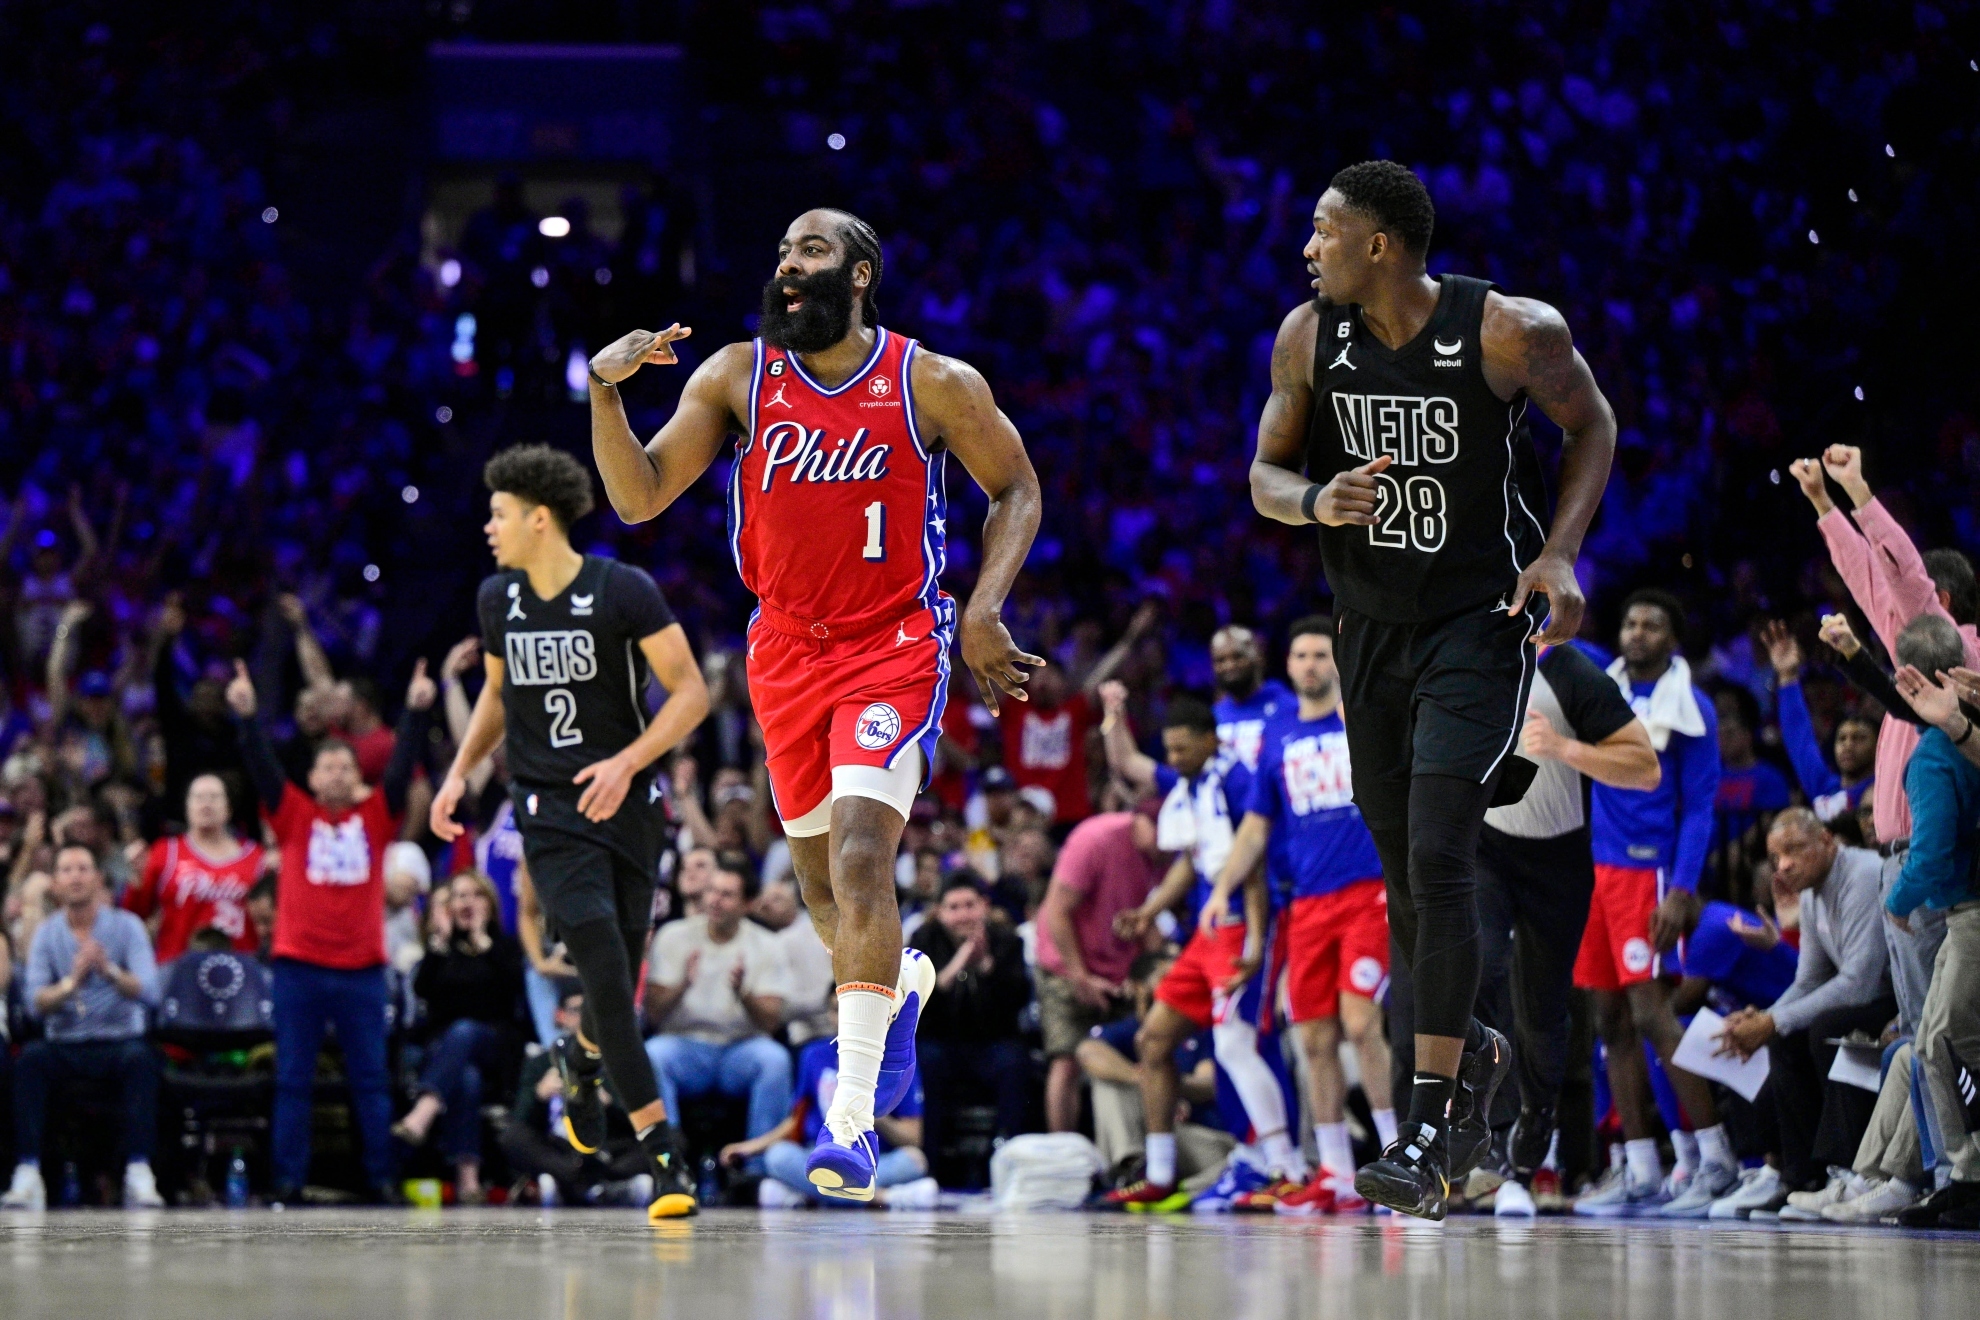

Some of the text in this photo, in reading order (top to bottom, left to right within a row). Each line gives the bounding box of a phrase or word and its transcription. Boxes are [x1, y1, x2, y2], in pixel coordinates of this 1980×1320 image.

[1337, 322, 1350, 338] 6
[771, 361, 783, 375] 6
[1434, 359, 1461, 367] Webull
[762, 421, 892, 493] Phila
[1332, 392, 1458, 466] NETS
[863, 501, 887, 562] 1
[1368, 473, 1447, 553] 28
[505, 630, 598, 686] NETS
[544, 689, 583, 748] 2
[859, 718, 891, 741] 76ers
